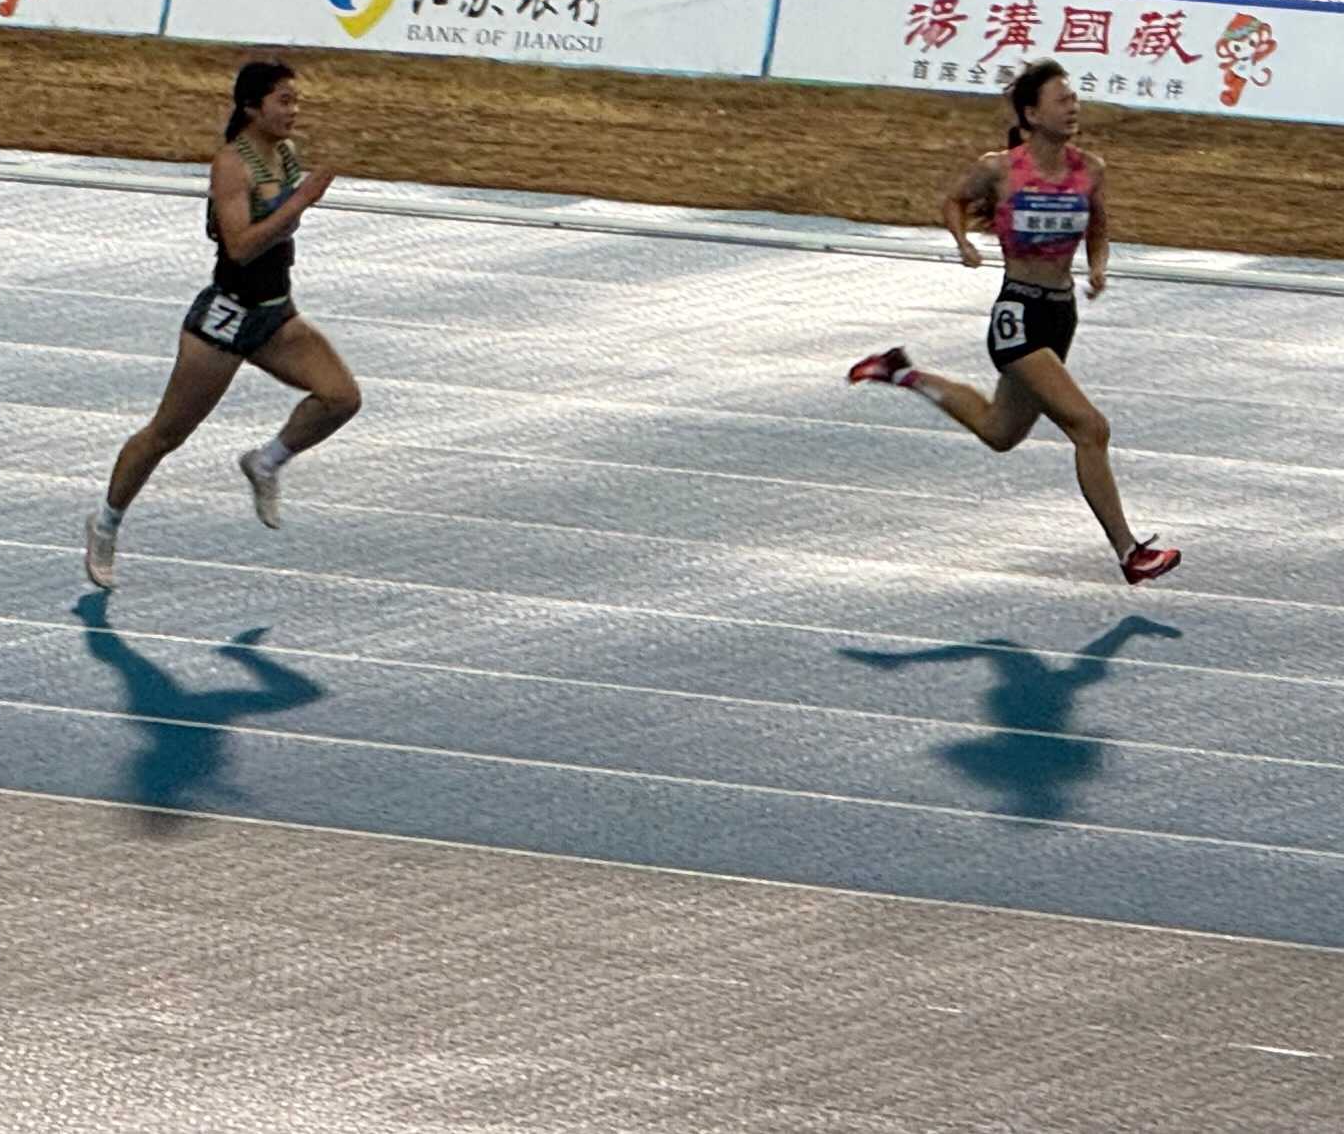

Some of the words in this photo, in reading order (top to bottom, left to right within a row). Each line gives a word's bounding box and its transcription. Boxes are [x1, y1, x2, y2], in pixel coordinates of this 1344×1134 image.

[407, 24, 468, 44] BANK
[476, 28, 507, 47] OF
[514, 31, 604, 54] JIANGSU
[214, 304, 238, 331] 7
[998, 309, 1017, 341] 6
